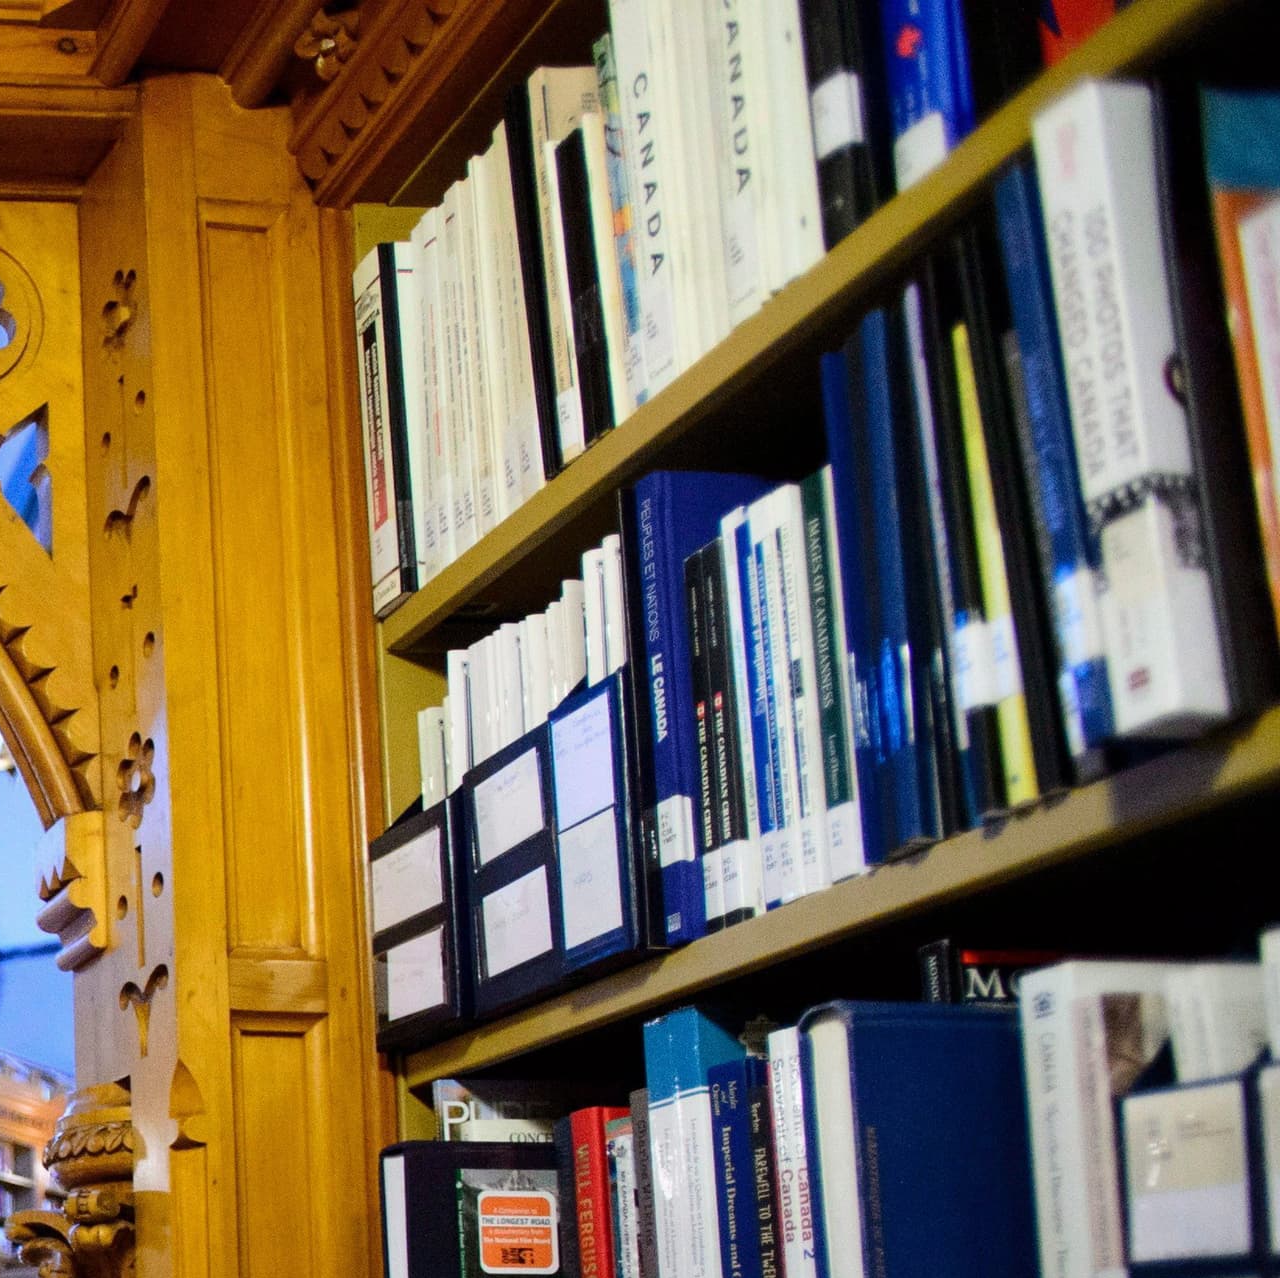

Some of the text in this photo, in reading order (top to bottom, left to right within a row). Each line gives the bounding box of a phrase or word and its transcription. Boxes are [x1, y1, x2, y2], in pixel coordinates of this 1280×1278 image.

[723, 0, 752, 195] ANADA
[632, 72, 665, 277] CANADA
[1050, 206, 1108, 482] CHANGED CANADA
[1094, 250, 1130, 379] PHOTOS
[1109, 384, 1140, 460] THAT
[640, 497, 668, 744] PEUPLES ET NATIONS LE CANADA
[807, 517, 835, 709] IMAGES OF CANADIANNESS
[697, 720, 713, 849] THE CANADIAN CRISIS
[715, 710, 732, 840] THE CANADIAN CRISIS
[721, 1126, 737, 1184] Imperial
[750, 1102, 761, 1134] Berton
[772, 1058, 798, 1243] Souvenir of Canada
[576, 1143, 592, 1192] WILL
[754, 1147, 771, 1201] FAREWELL
[481, 1217, 551, 1226] THE LONGEST ROAD
[482, 1237, 551, 1245] The National Film Board
[726, 1188, 738, 1240] Dreams
[759, 1204, 772, 1221] TO
[760, 1223, 775, 1246] THE
[798, 1167, 815, 1261] Canada 2
[730, 1242, 739, 1267] and
